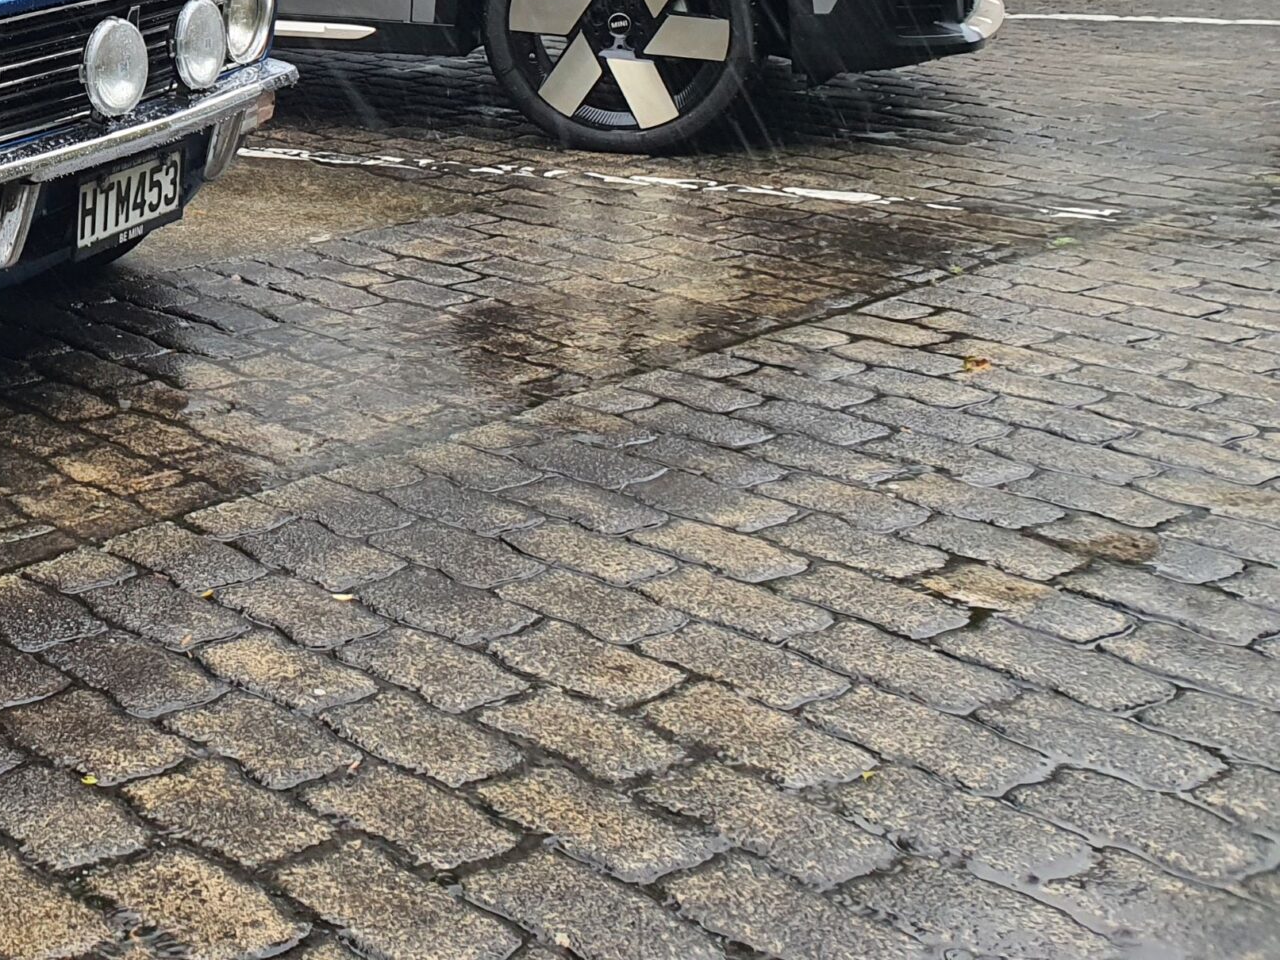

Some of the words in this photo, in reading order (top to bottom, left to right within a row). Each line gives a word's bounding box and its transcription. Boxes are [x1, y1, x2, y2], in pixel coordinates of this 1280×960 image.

[610, 19, 628, 29] MINI
[80, 160, 179, 240] HTM453
[119, 231, 128, 244] BE
[128, 224, 144, 240] MINI
